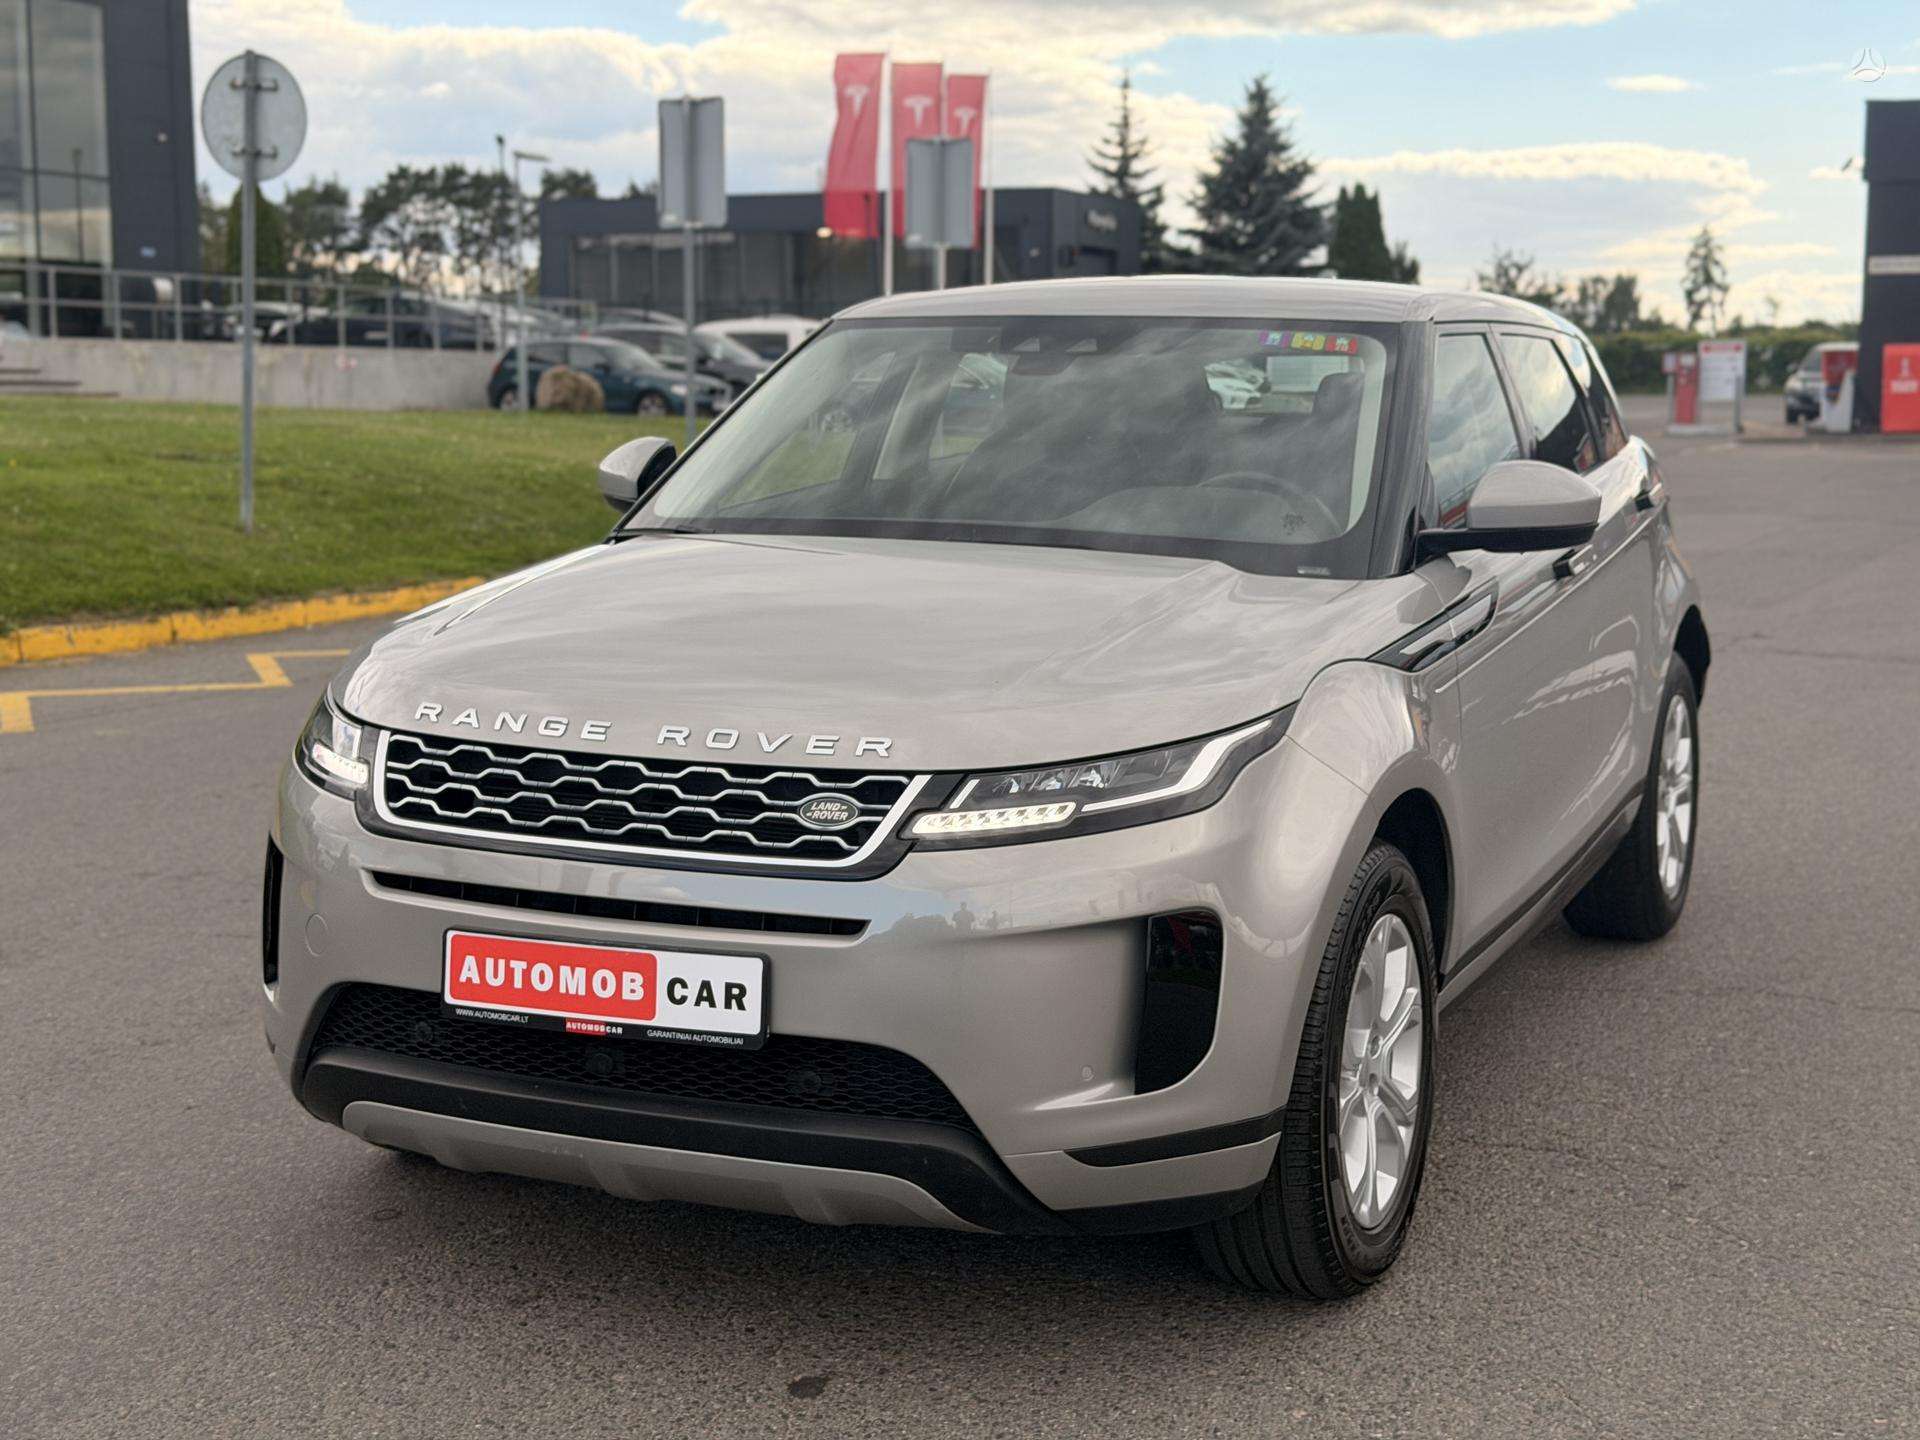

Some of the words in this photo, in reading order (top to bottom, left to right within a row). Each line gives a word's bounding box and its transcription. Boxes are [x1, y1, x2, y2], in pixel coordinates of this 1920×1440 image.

[415, 702, 612, 742] RANGE
[657, 725, 893, 757] ROVER
[810, 802, 841, 810] LAND
[811, 810, 849, 820] ROVER
[459, 955, 645, 1001] AUTOMOB
[666, 976, 748, 1011] CAR
